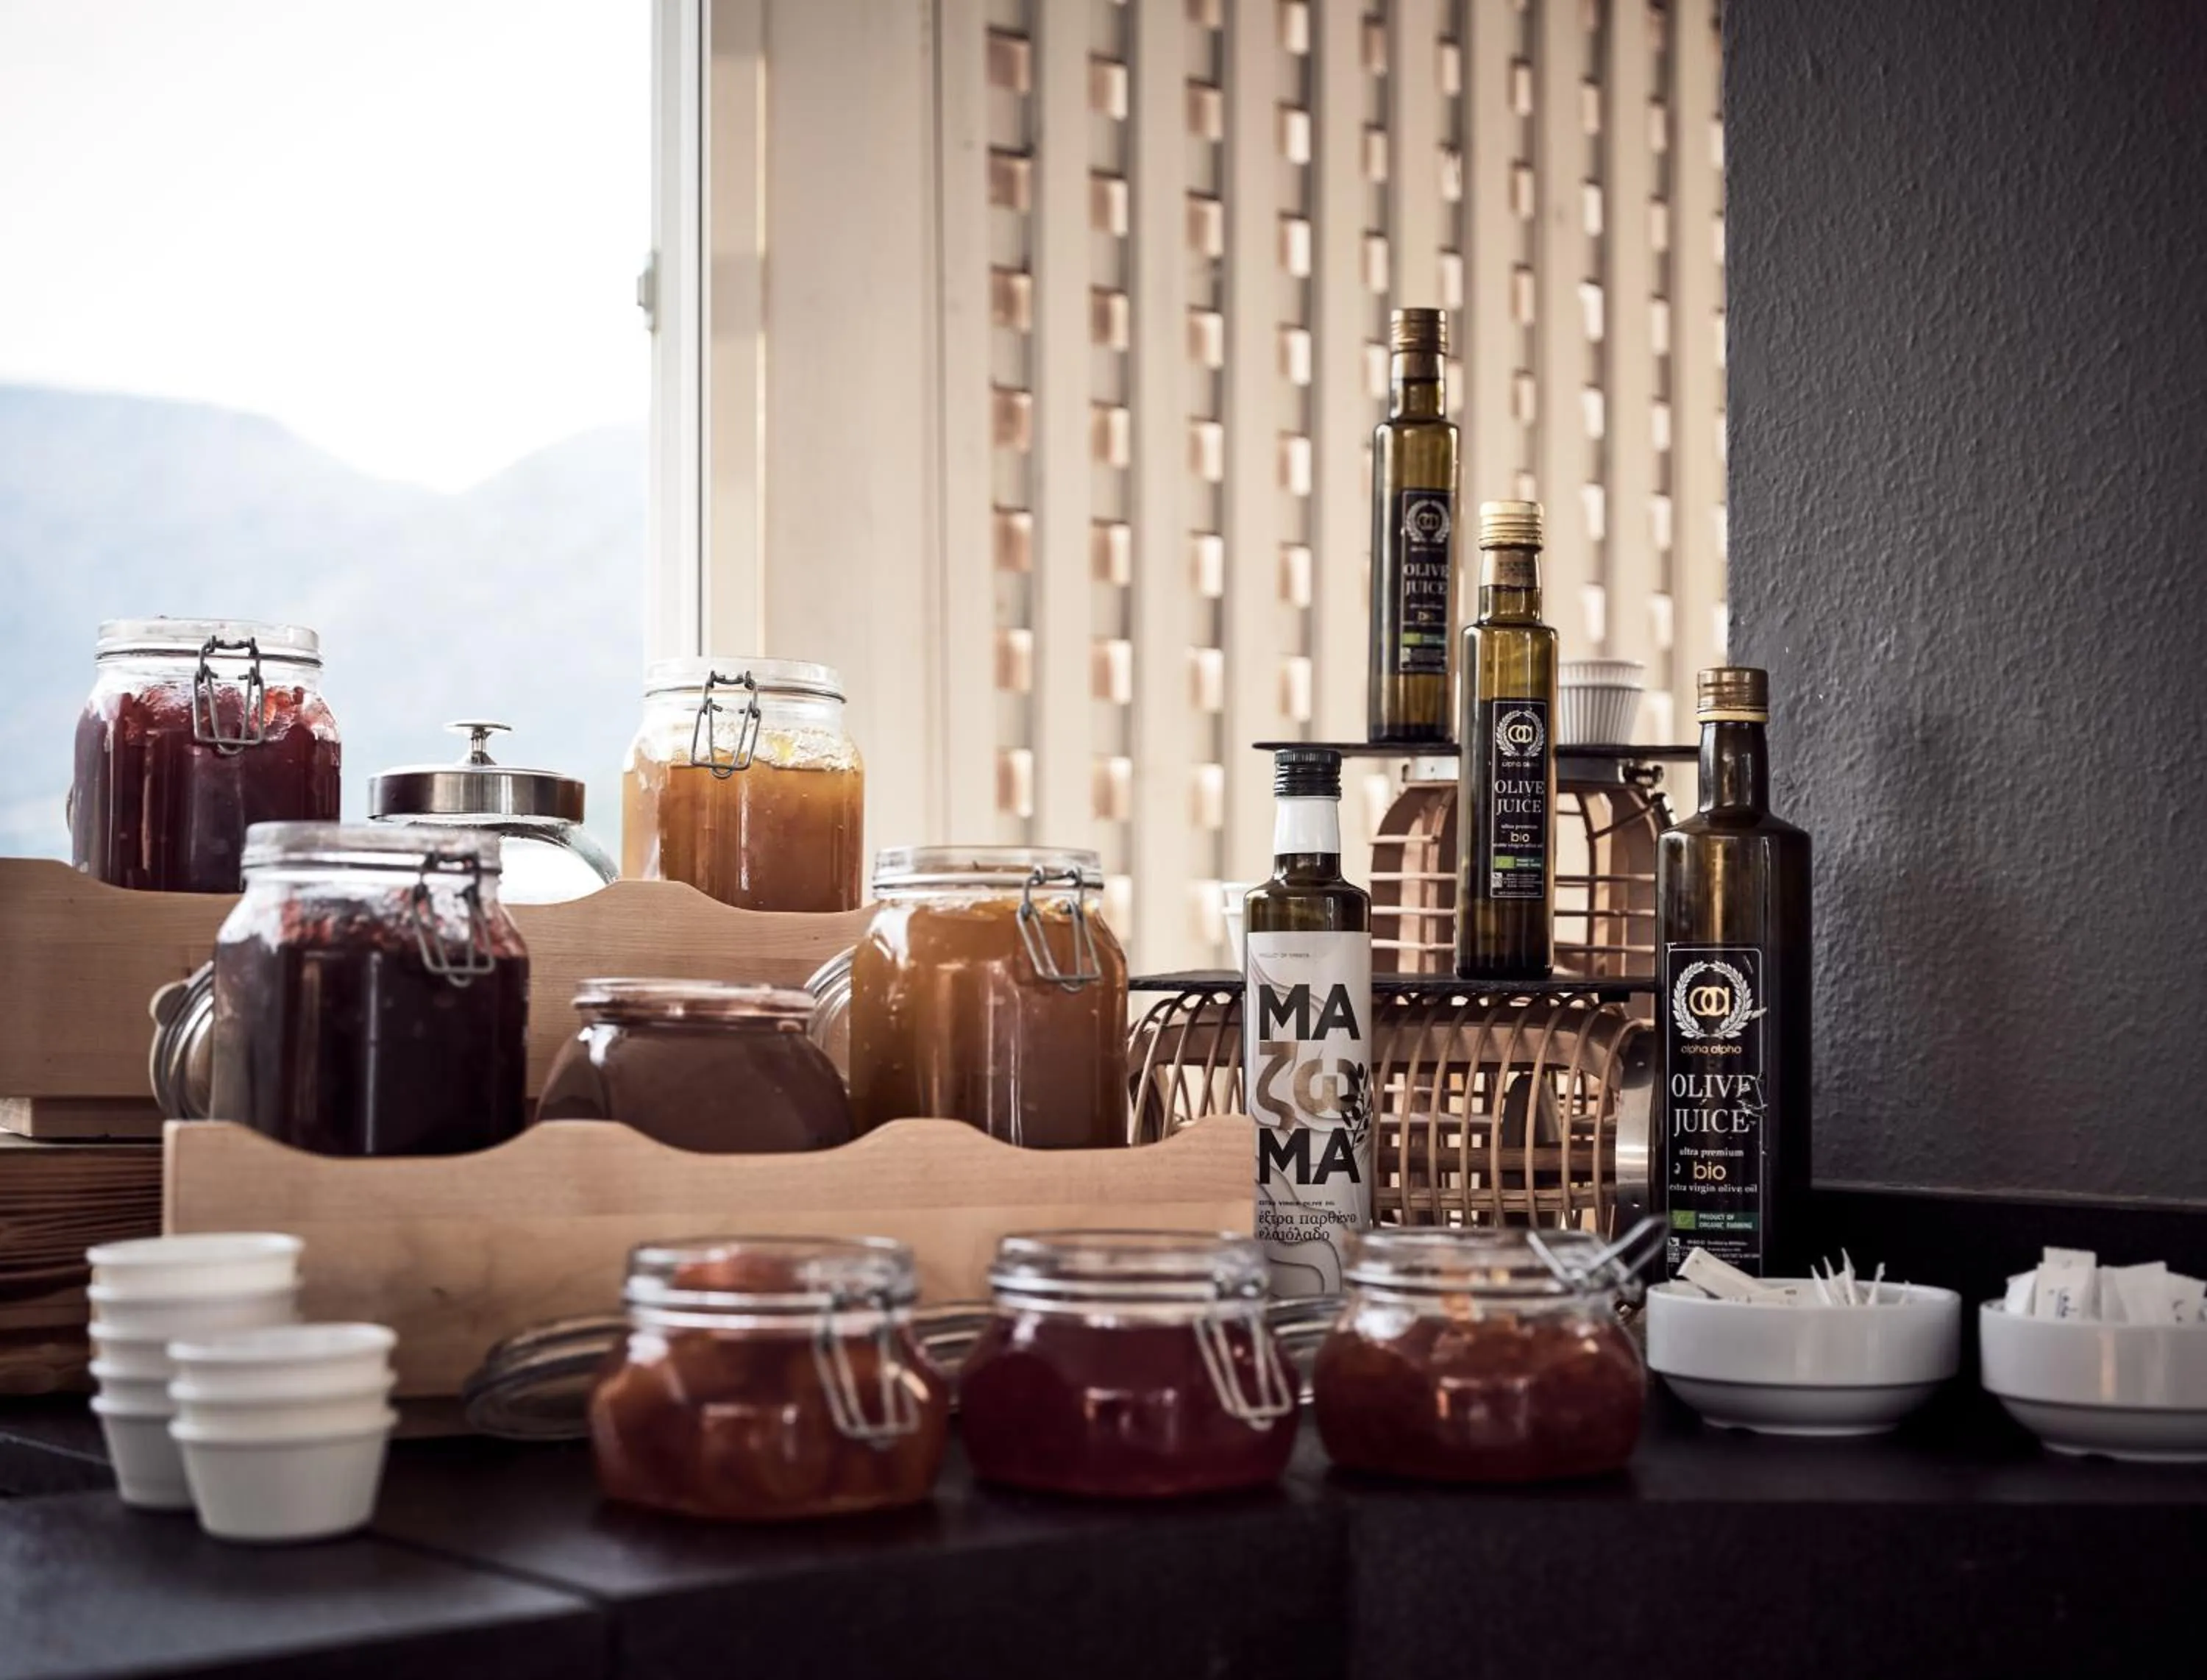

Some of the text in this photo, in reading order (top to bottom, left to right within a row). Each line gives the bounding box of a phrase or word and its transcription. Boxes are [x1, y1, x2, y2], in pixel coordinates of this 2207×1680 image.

[1403, 563, 1450, 577] OLIVE
[1406, 580, 1447, 595] JUICE
[1495, 780, 1544, 794] OLIVE
[1496, 799, 1541, 815] JUICE
[1510, 832, 1530, 842] bio
[1259, 984, 1360, 1040] MA
[1671, 1074, 1755, 1098] OLIVE
[1674, 1108, 1751, 1136] JUICE
[1259, 1128, 1360, 1184] MA
[1701, 1147, 1744, 1158] premium
[1694, 1161, 1727, 1180] bio
[1689, 1183, 1716, 1195] virgin
[1718, 1184, 1742, 1192] olive
[1744, 1184, 1757, 1192] oil
